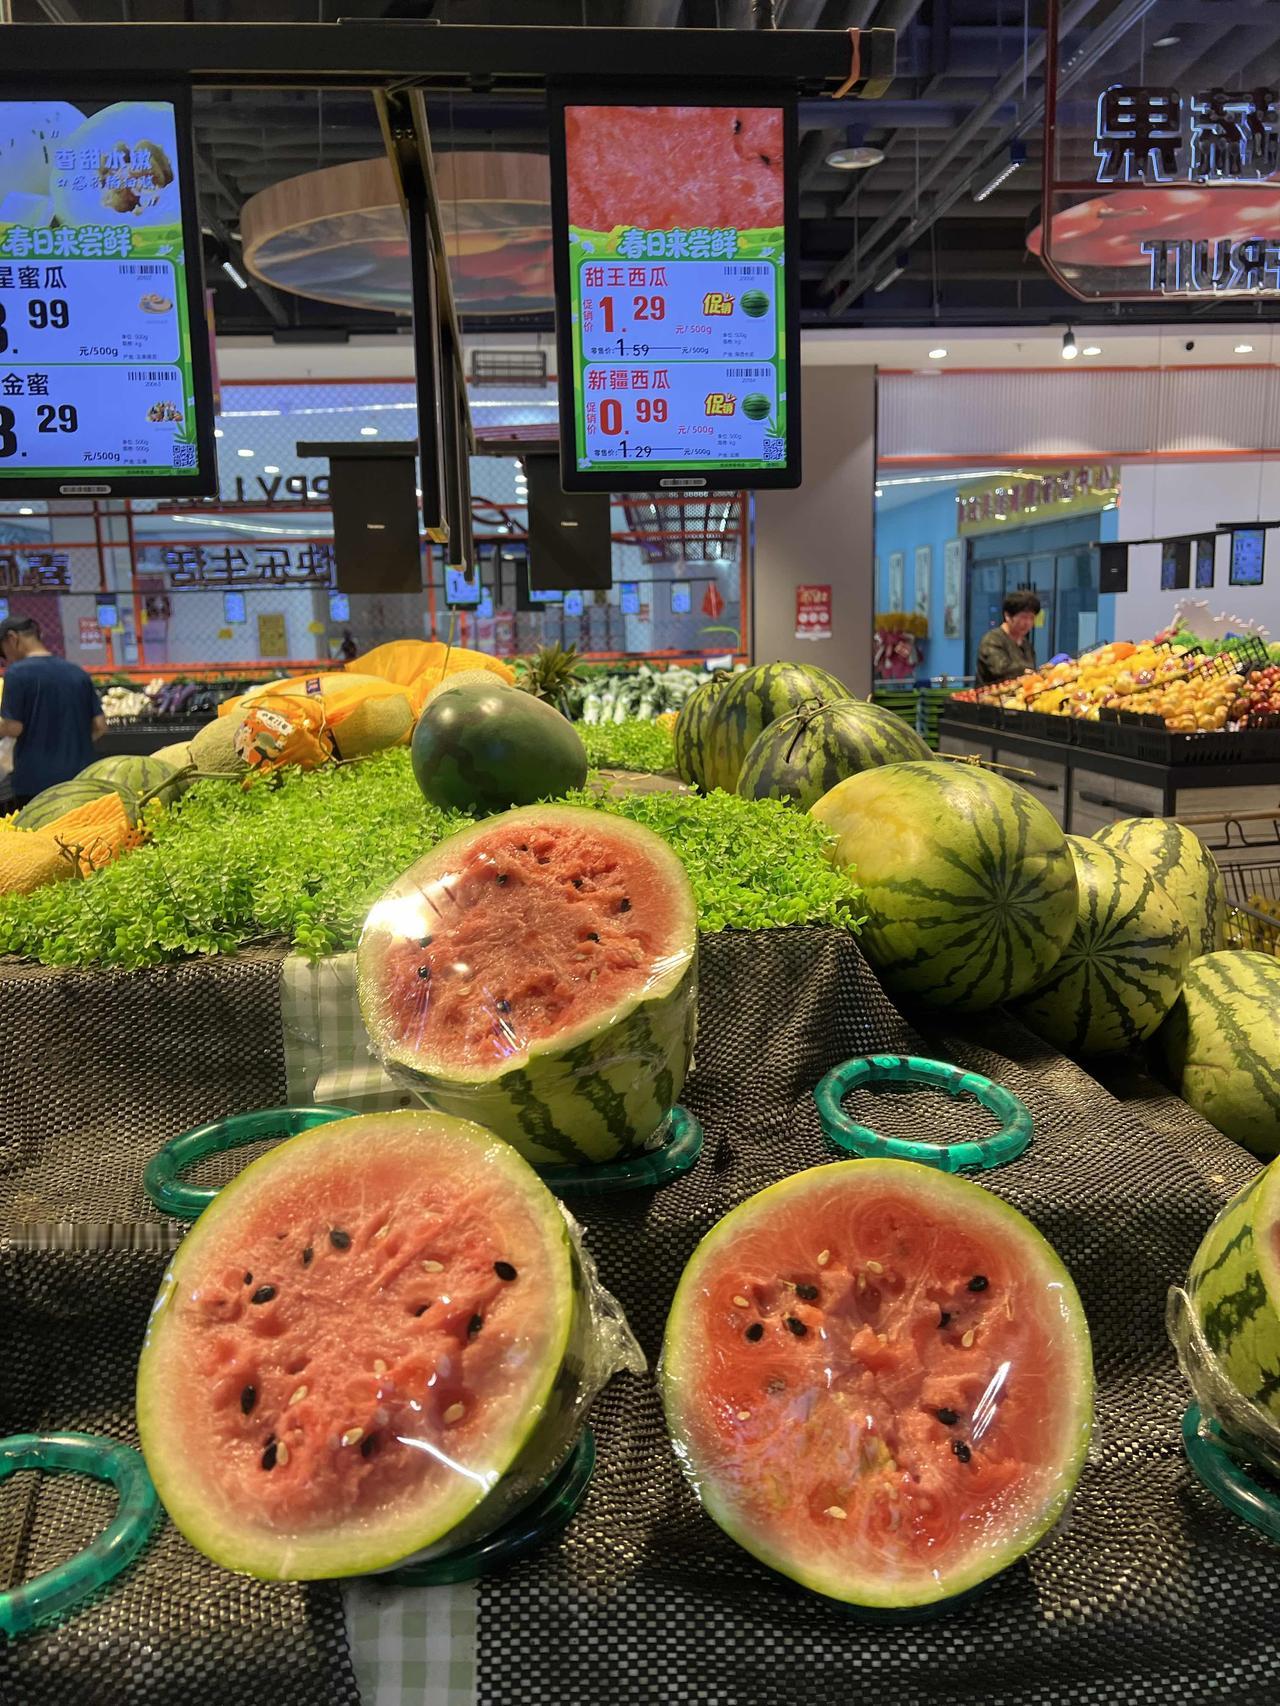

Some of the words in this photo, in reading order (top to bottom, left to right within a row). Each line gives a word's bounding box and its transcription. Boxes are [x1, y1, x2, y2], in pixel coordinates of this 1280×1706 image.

[3, 226, 132, 257] 春日来尝鲜
[617, 228, 738, 258] 春日来尝鲜
[0, 266, 67, 289] 星蜜瓜
[585, 267, 668, 287] 甜王西瓜
[583, 299, 593, 332] 促销价
[79, 346, 119, 358] 元/500g
[616, 338, 649, 357] 1.59
[2, 373, 49, 396] 金蜜
[588, 369, 670, 390] 新疆西瓜
[705, 394, 736, 416] 促销
[586, 402, 596, 435] 促销价
[678, 425, 714, 435] 元/500g
[83, 452, 121, 462] 元/500g
[619, 440, 652, 458] 1.29
